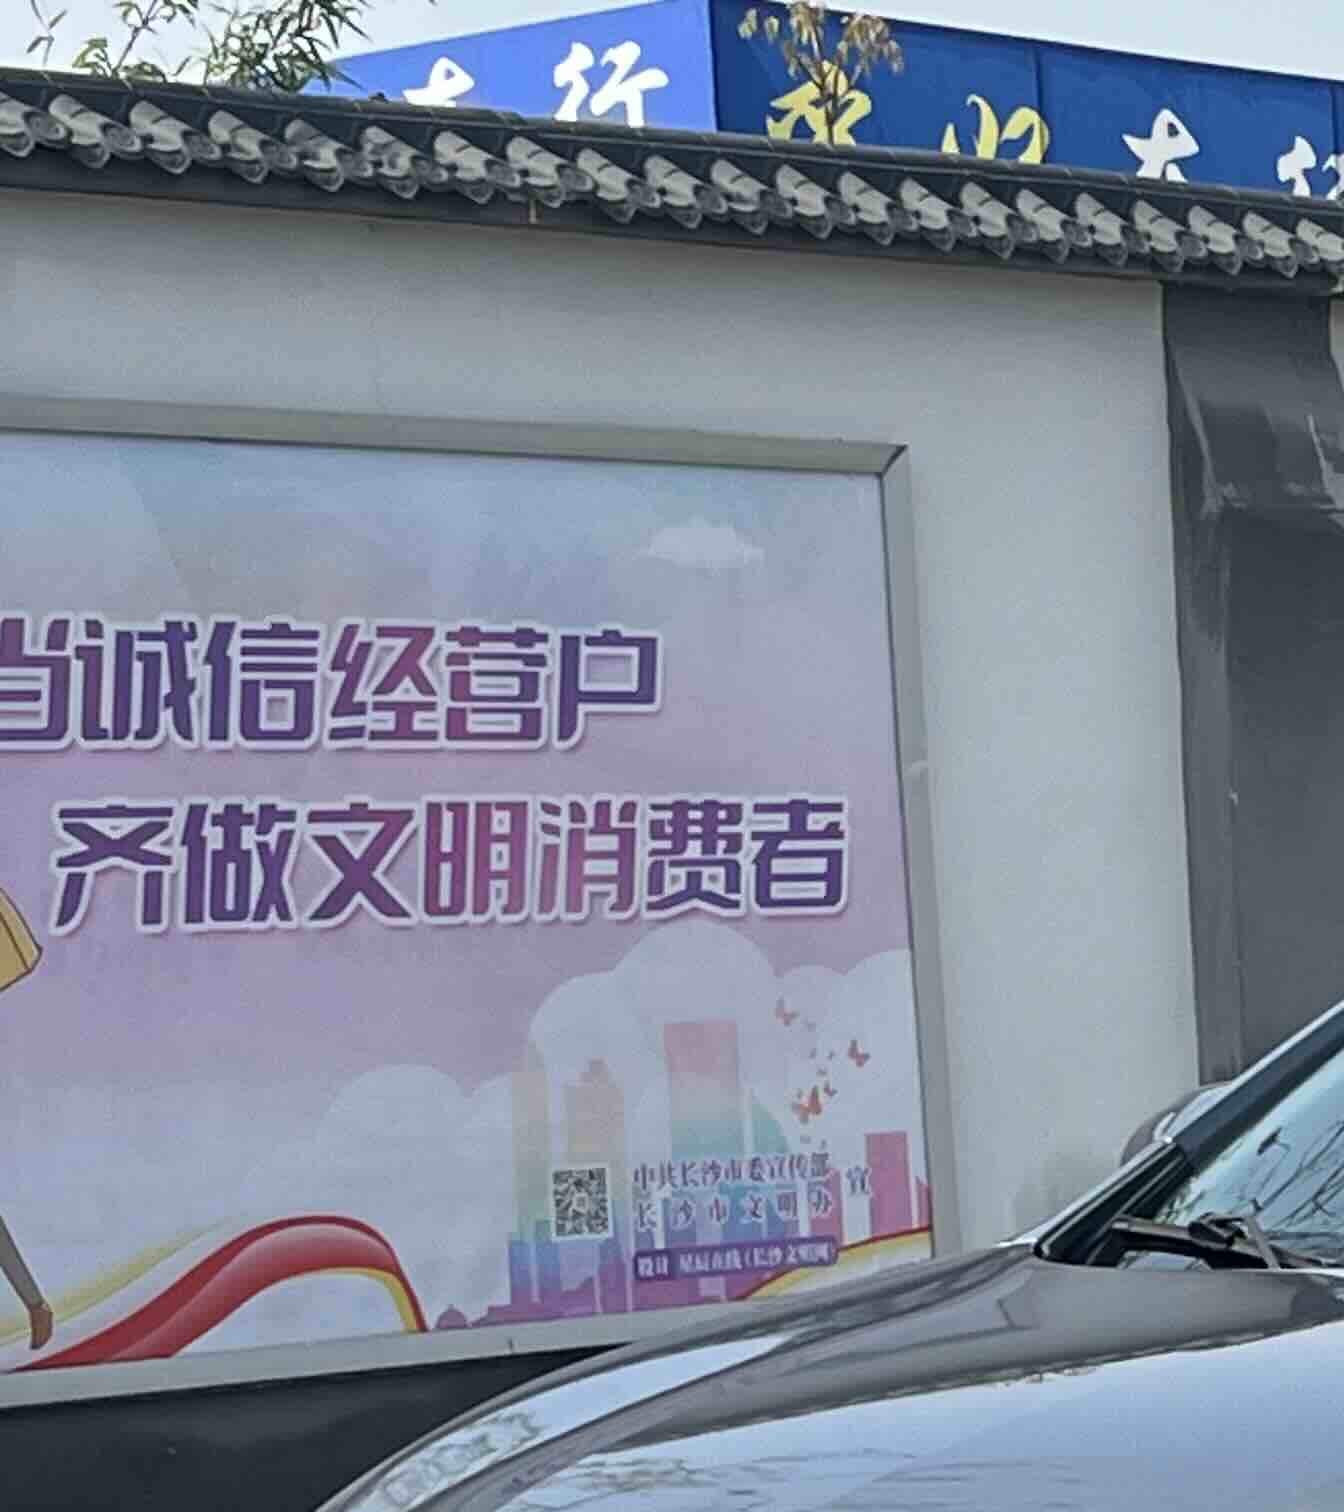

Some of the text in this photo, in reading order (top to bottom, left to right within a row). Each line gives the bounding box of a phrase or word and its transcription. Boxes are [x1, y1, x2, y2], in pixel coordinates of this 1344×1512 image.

[55, 800, 846, 927] 齐做文明消费者
